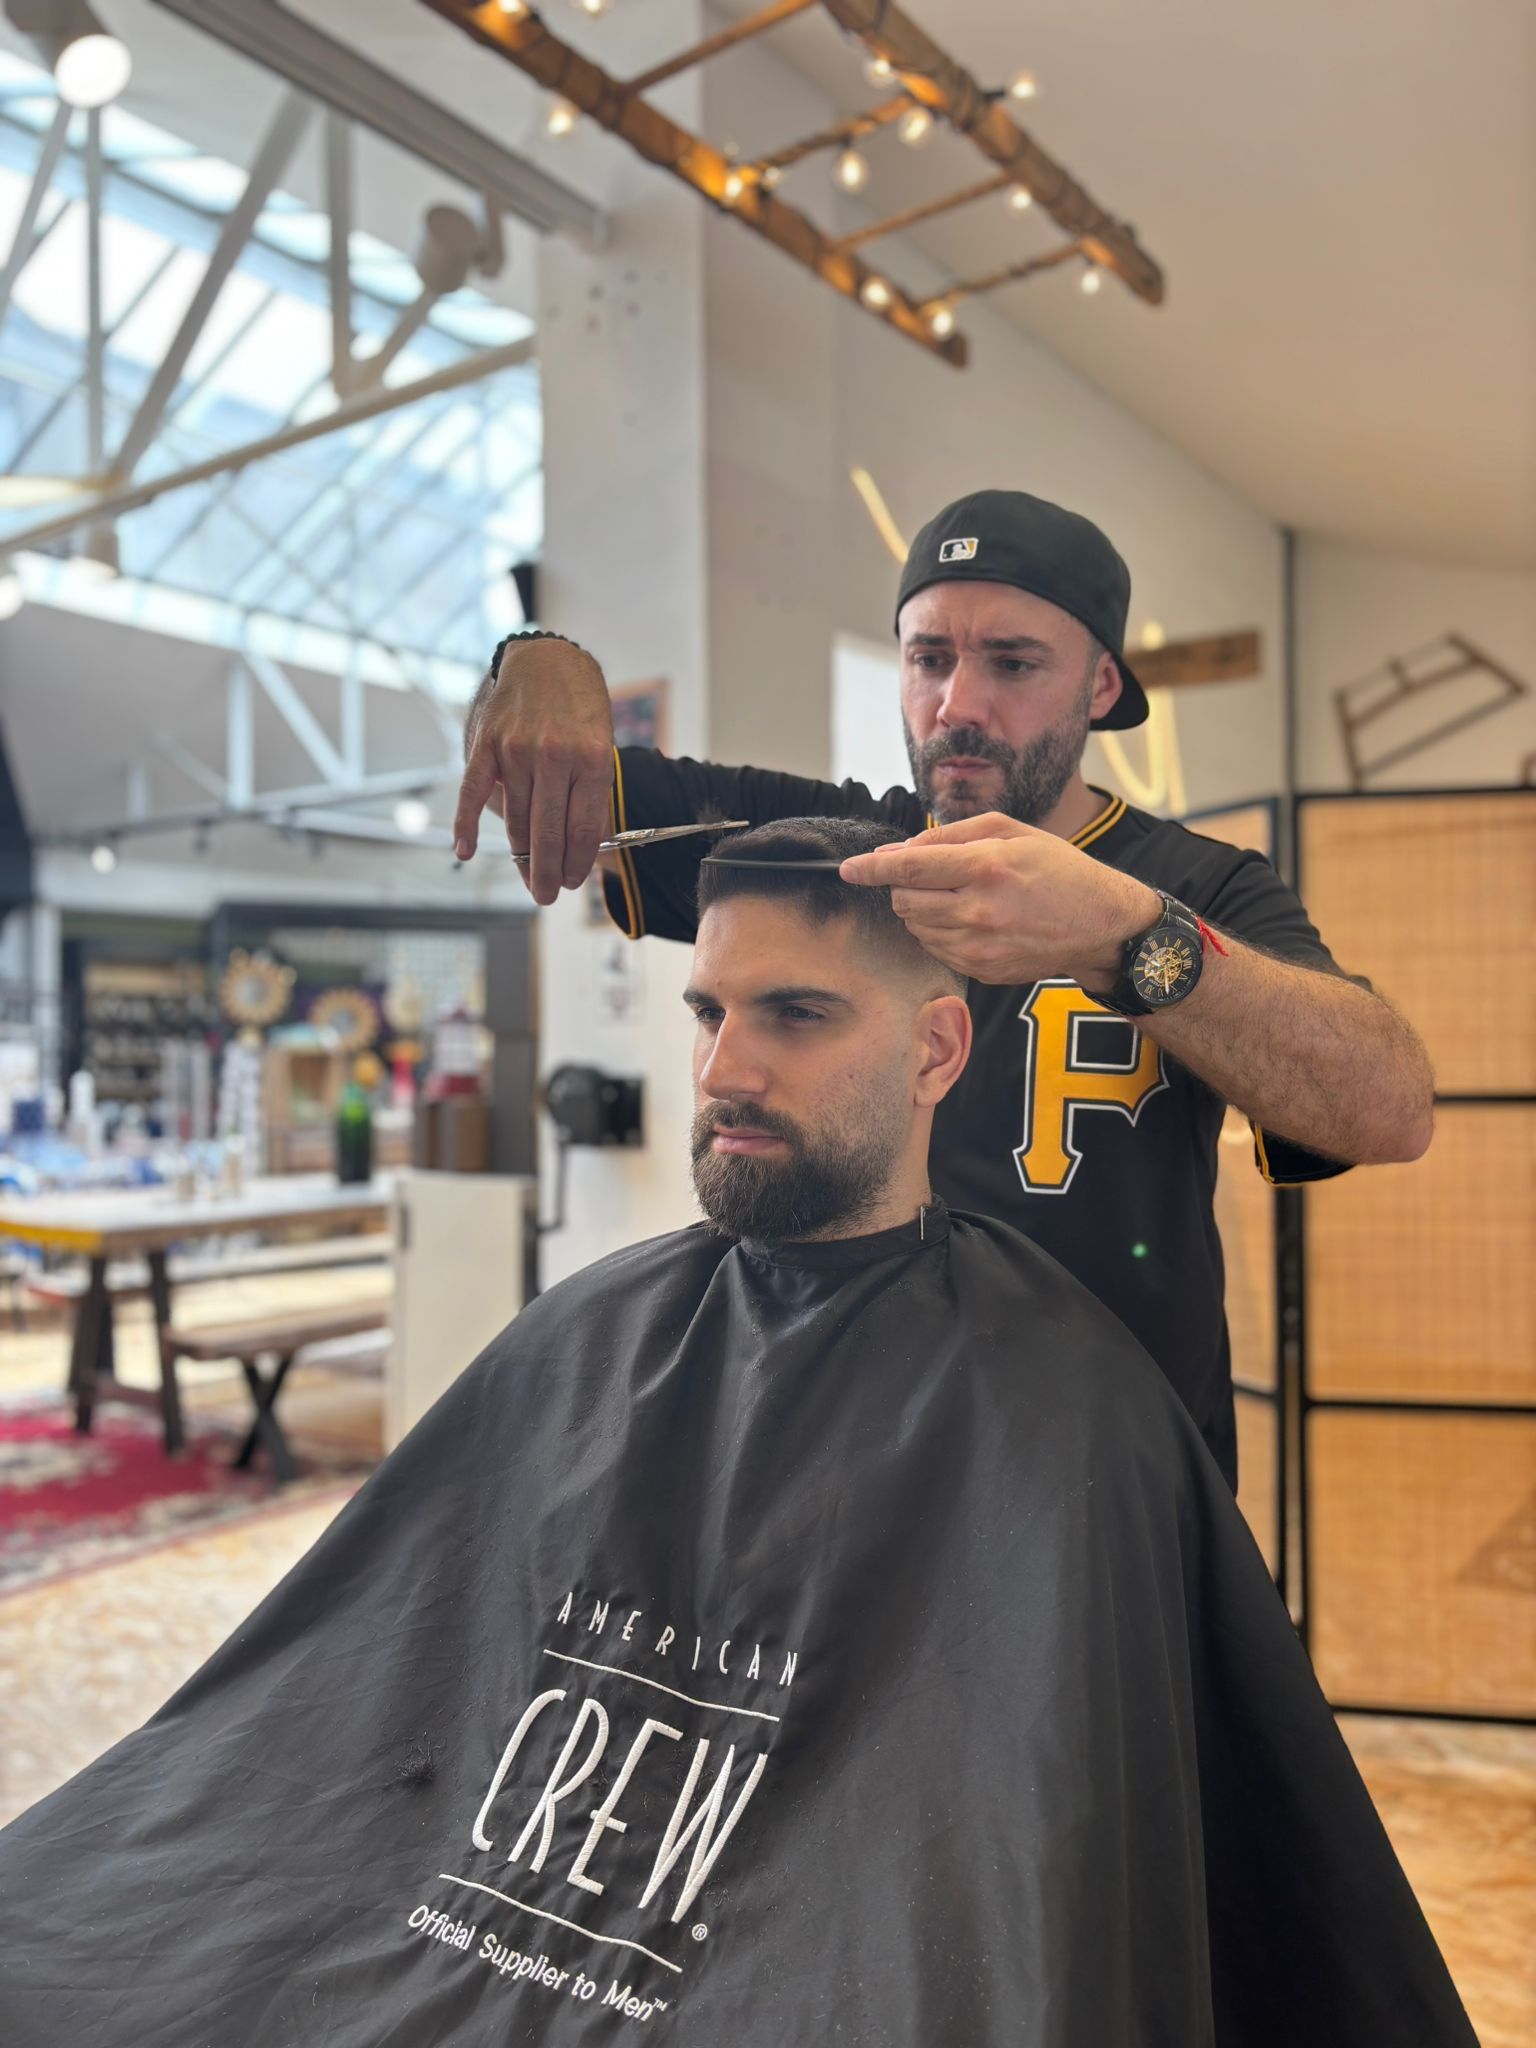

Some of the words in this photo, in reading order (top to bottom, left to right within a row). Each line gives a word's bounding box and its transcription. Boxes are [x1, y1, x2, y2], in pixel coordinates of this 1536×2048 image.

[1012, 978, 1171, 1195] P
[557, 1591, 799, 1686] AMERICAN
[472, 1688, 769, 1923] CREW
[407, 1904, 477, 1951] Official
[478, 1933, 570, 1991] Supplier
[571, 1972, 597, 2001] to
